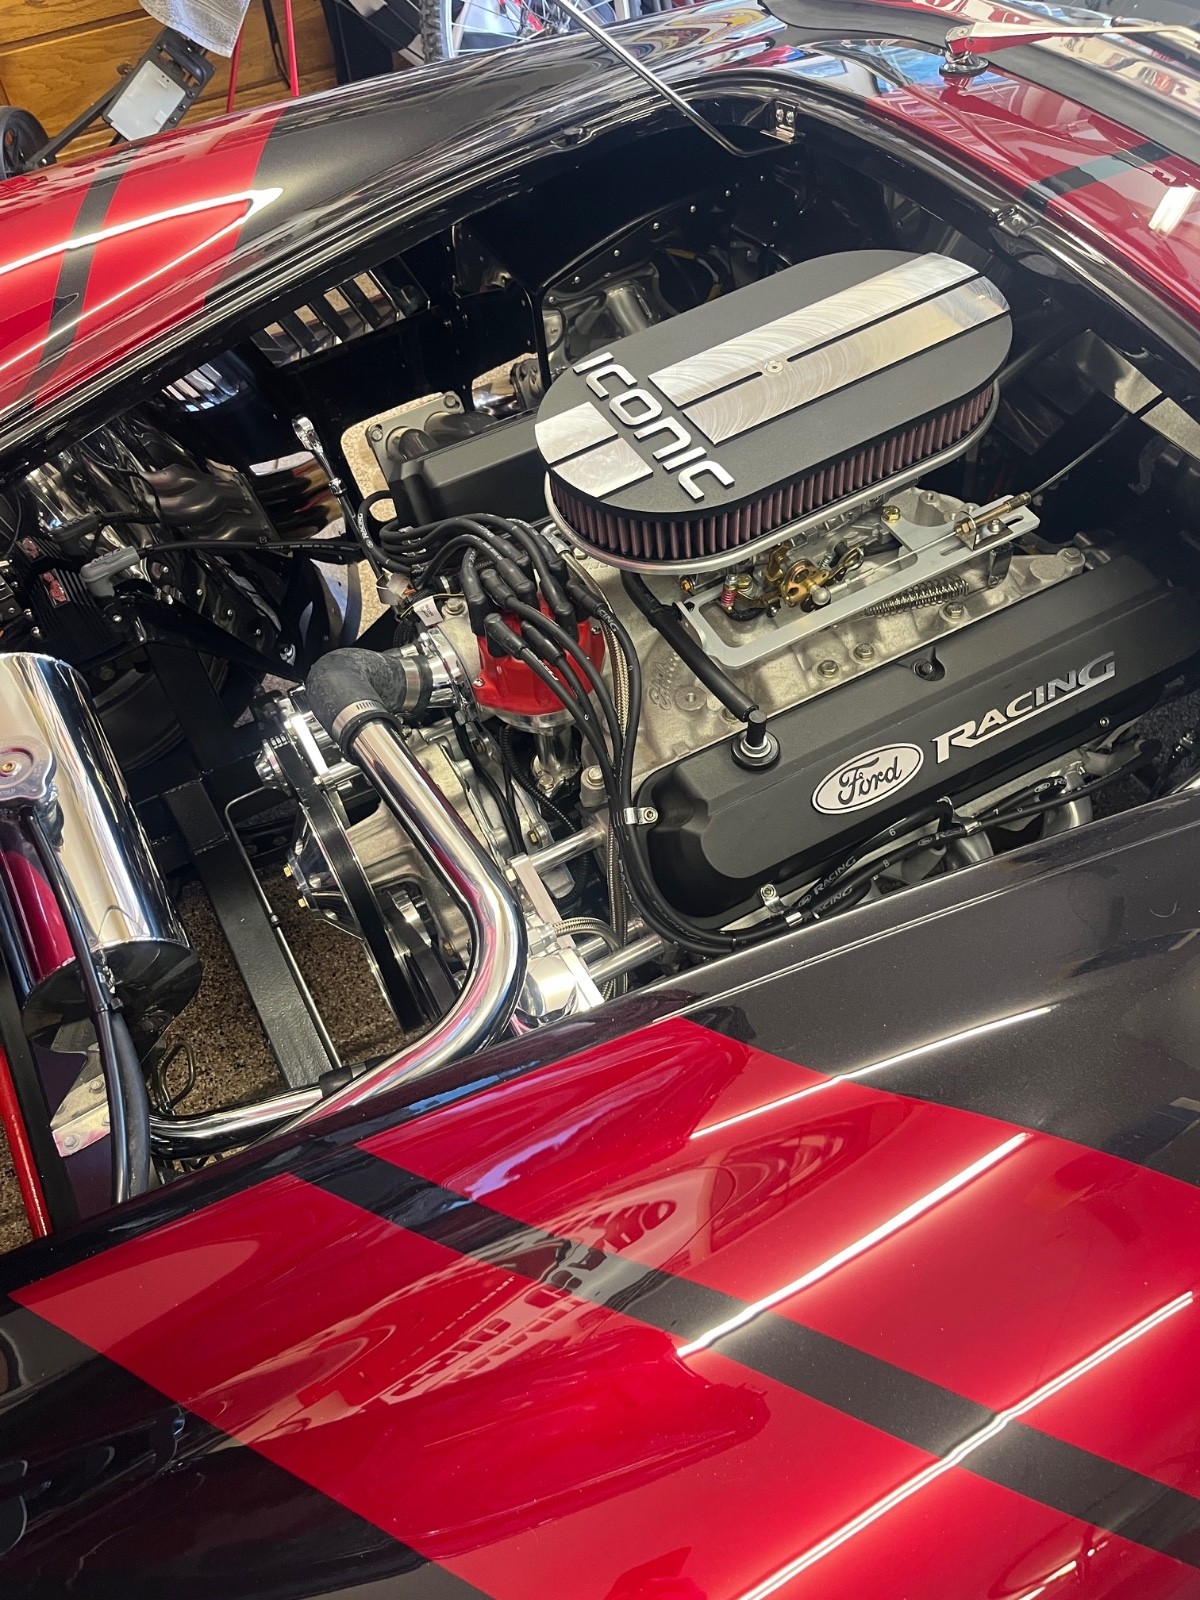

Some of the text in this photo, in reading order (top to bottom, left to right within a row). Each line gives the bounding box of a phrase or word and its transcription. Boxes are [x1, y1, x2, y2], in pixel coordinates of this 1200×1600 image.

[837, 650, 1116, 806] Ford RACING
[813, 855, 857, 896] RACING
